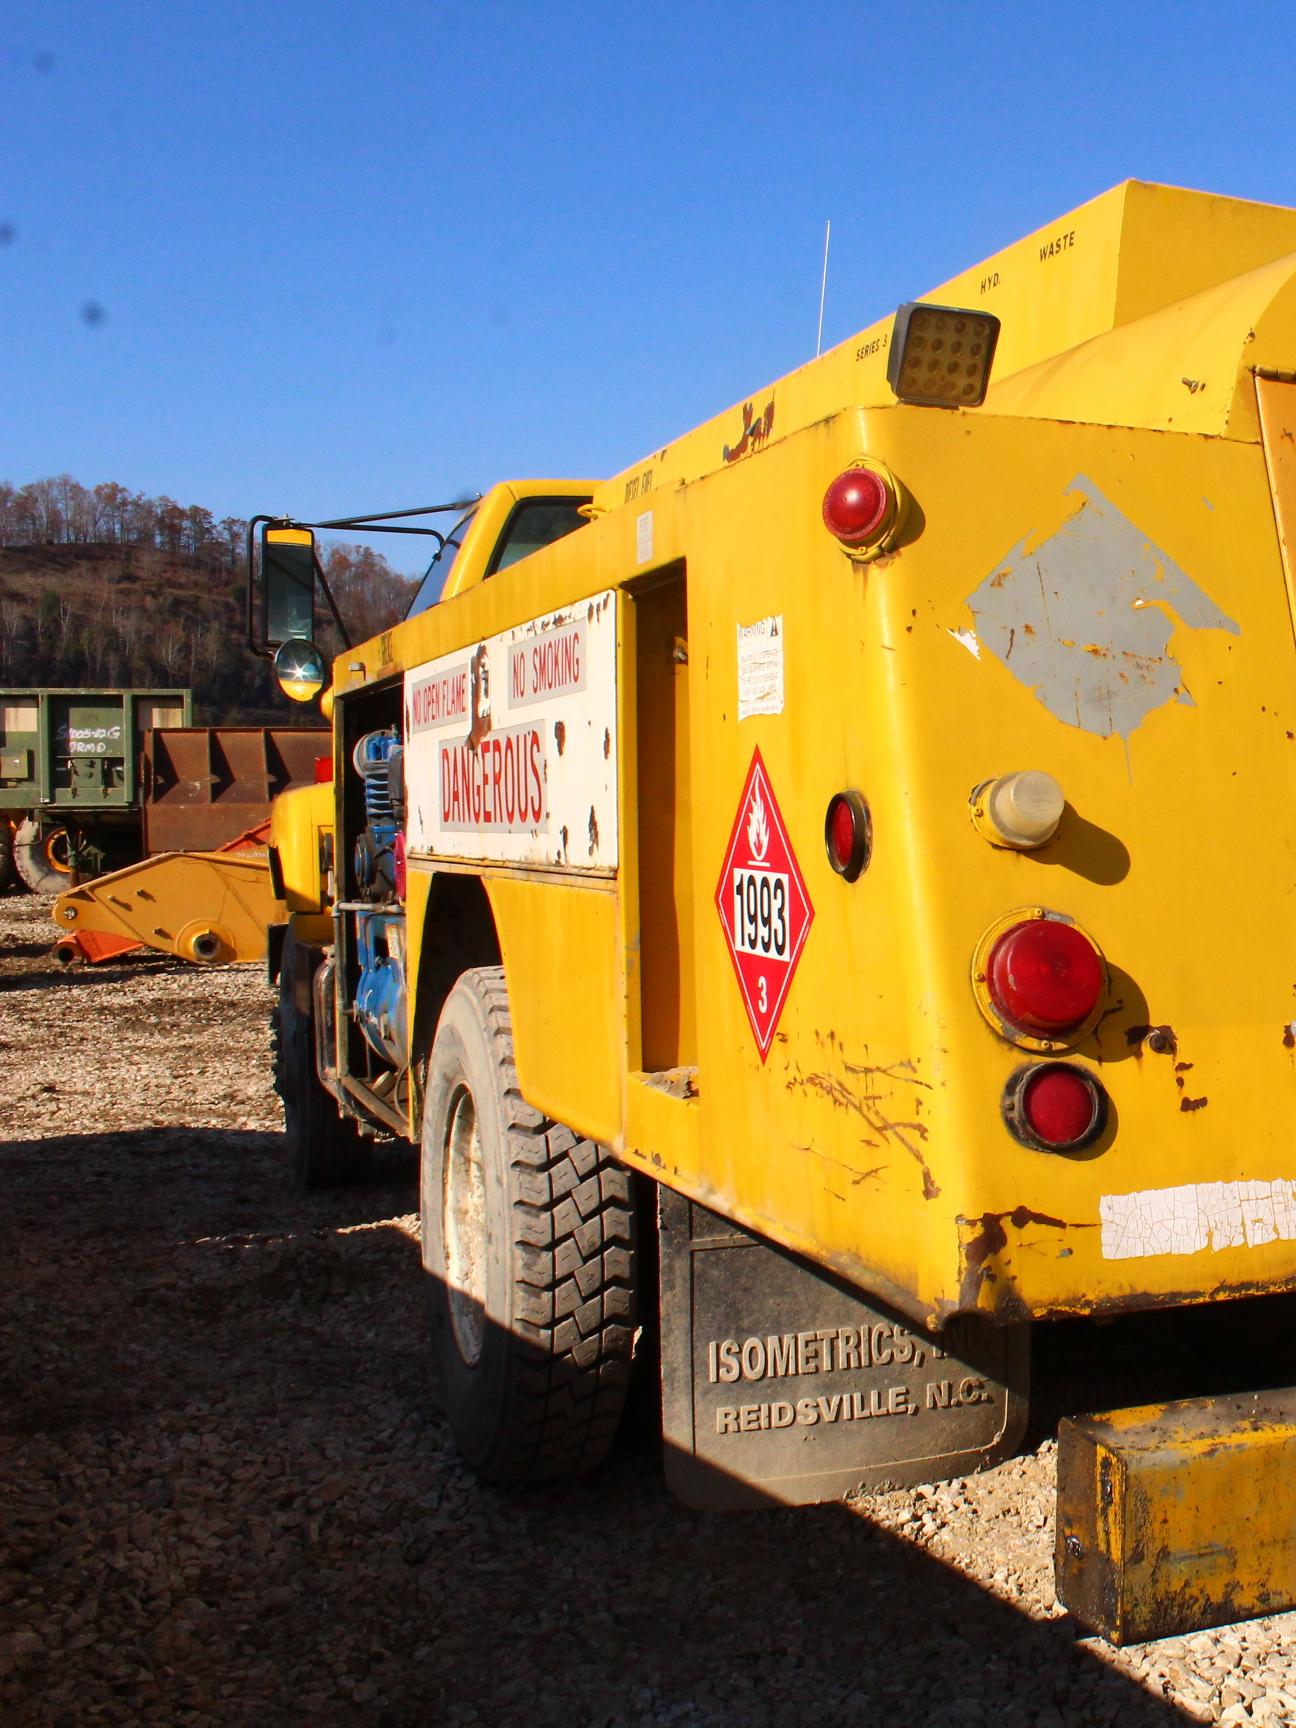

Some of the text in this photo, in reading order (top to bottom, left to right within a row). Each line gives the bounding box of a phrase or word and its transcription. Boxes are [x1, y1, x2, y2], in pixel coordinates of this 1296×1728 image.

[1039, 230, 1076, 262] WASTE
[979, 271, 1001, 295] HYD.
[855, 334, 888, 362] SERIES 3
[512, 631, 581, 699] NO SMOKING
[413, 672, 467, 727] NO OPEN FLAME
[442, 728, 543, 824] DANGEROUS
[735, 873, 786, 957] 1993
[757, 975, 769, 1015] 3
[709, 1322, 924, 1384] ISOMETRICS,
[716, 1376, 990, 1434] REIDSVILLE, N.C.
